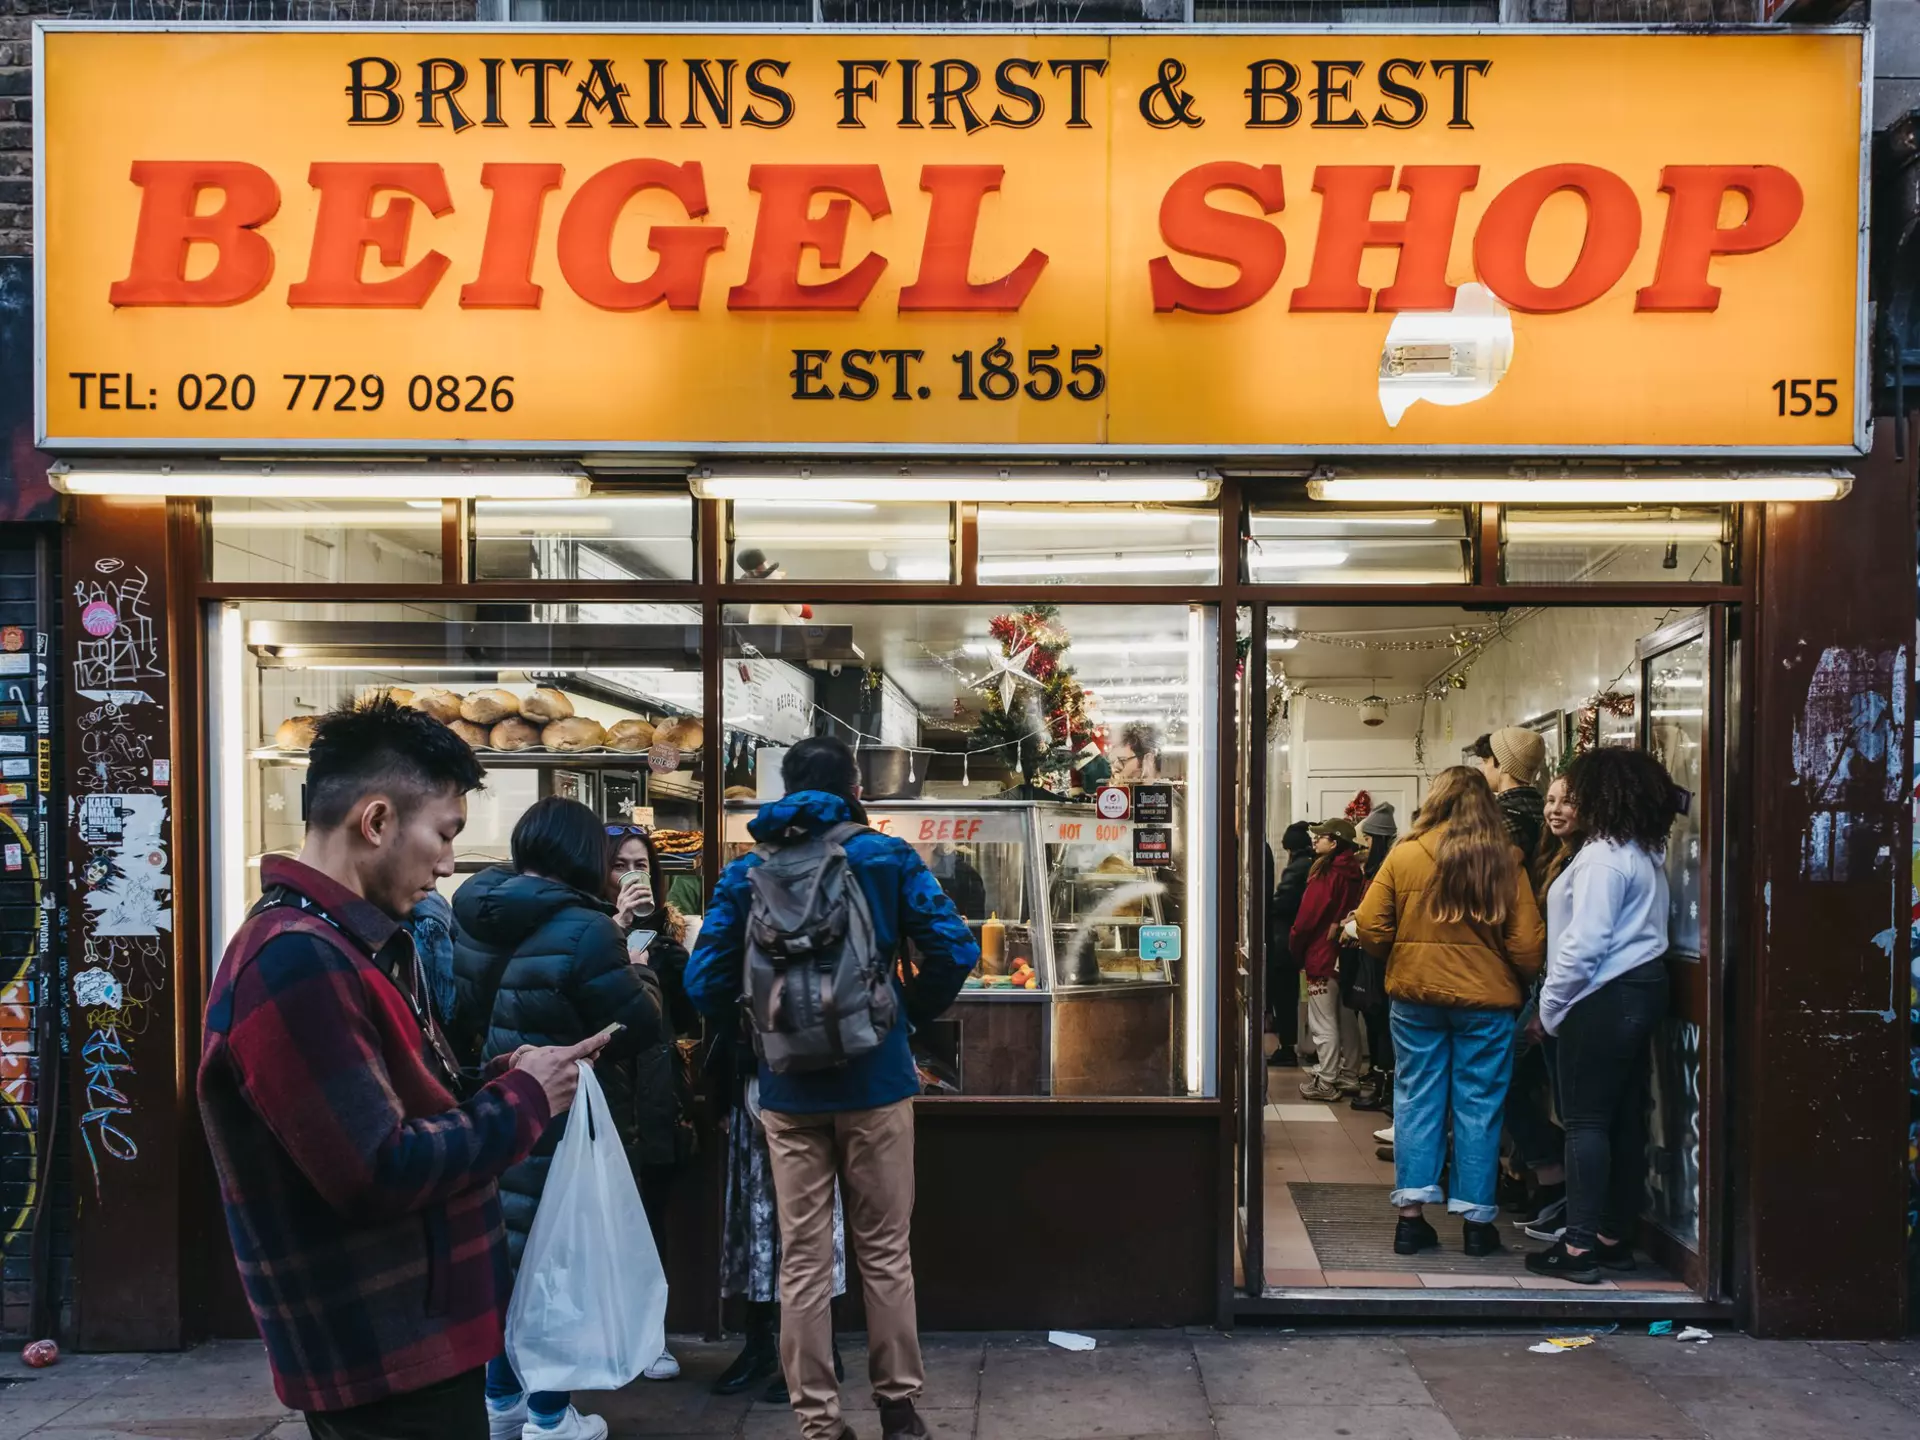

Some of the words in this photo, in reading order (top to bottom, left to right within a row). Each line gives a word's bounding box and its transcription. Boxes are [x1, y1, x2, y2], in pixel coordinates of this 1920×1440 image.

[345, 57, 795, 134] BRITAINS
[835, 58, 1107, 134] FIRST
[1139, 58, 1205, 129] &
[1243, 59, 1493, 130] BEST
[109, 157, 1049, 312] BEIGEL
[1148, 160, 1804, 314] SHOP
[789, 348, 932, 402] EST.
[953, 338, 1106, 402] 1855
[69, 372, 158, 411] TEL:
[176, 373, 256, 412] 020
[283, 374, 385, 412] 7729
[407, 375, 515, 414] 0826
[1772, 378, 1839, 417] 155
[88, 797, 111, 807] KARL
[88, 807, 115, 818] MARX
[88, 817, 122, 825] WALKING
[103, 824, 122, 832] TOUR
[918, 819, 985, 841] BEEF
[1059, 823, 1083, 840] HOT
[40, 910, 49, 953] KEYWORDS
